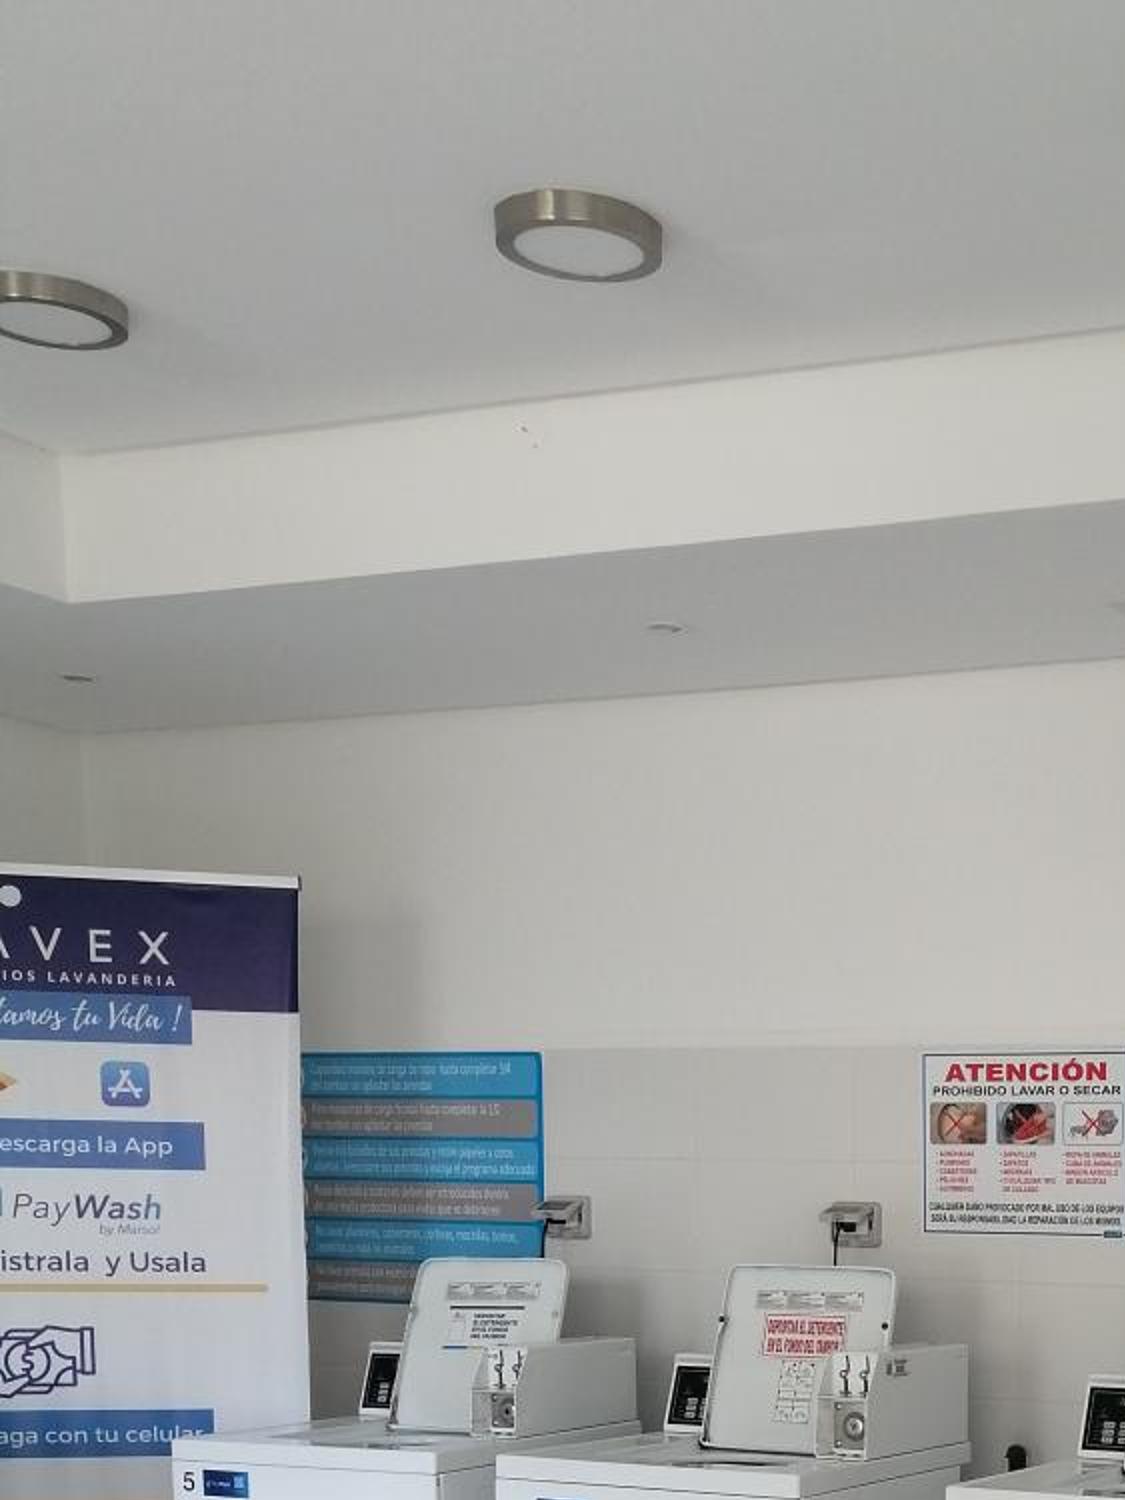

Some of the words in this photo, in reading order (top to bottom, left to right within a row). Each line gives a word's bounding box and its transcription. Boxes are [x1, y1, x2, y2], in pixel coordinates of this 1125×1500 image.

[47, 971, 177, 987] LAVANDERIA
[71, 1000, 100, 1031] tu
[108, 1001, 163, 1031] Vida
[945, 1058, 1108, 1082] ATENCIÓN
[932, 1085, 1007, 1096] PROHIBIDO
[1011, 1085, 1055, 1096] LAVAR
[1059, 1085, 1069, 1096] O
[1073, 1085, 1121, 1096] SECAR
[98, 1136, 117, 1153] la
[124, 1137, 173, 1158] App
[12, 1193, 161, 1227] PayWash
[105, 1256, 121, 1277] y
[130, 1251, 206, 1273] Usala
[45, 1429, 88, 1444] con
[95, 1427, 120, 1444] tu
[183, 1471, 195, 1491] 5
